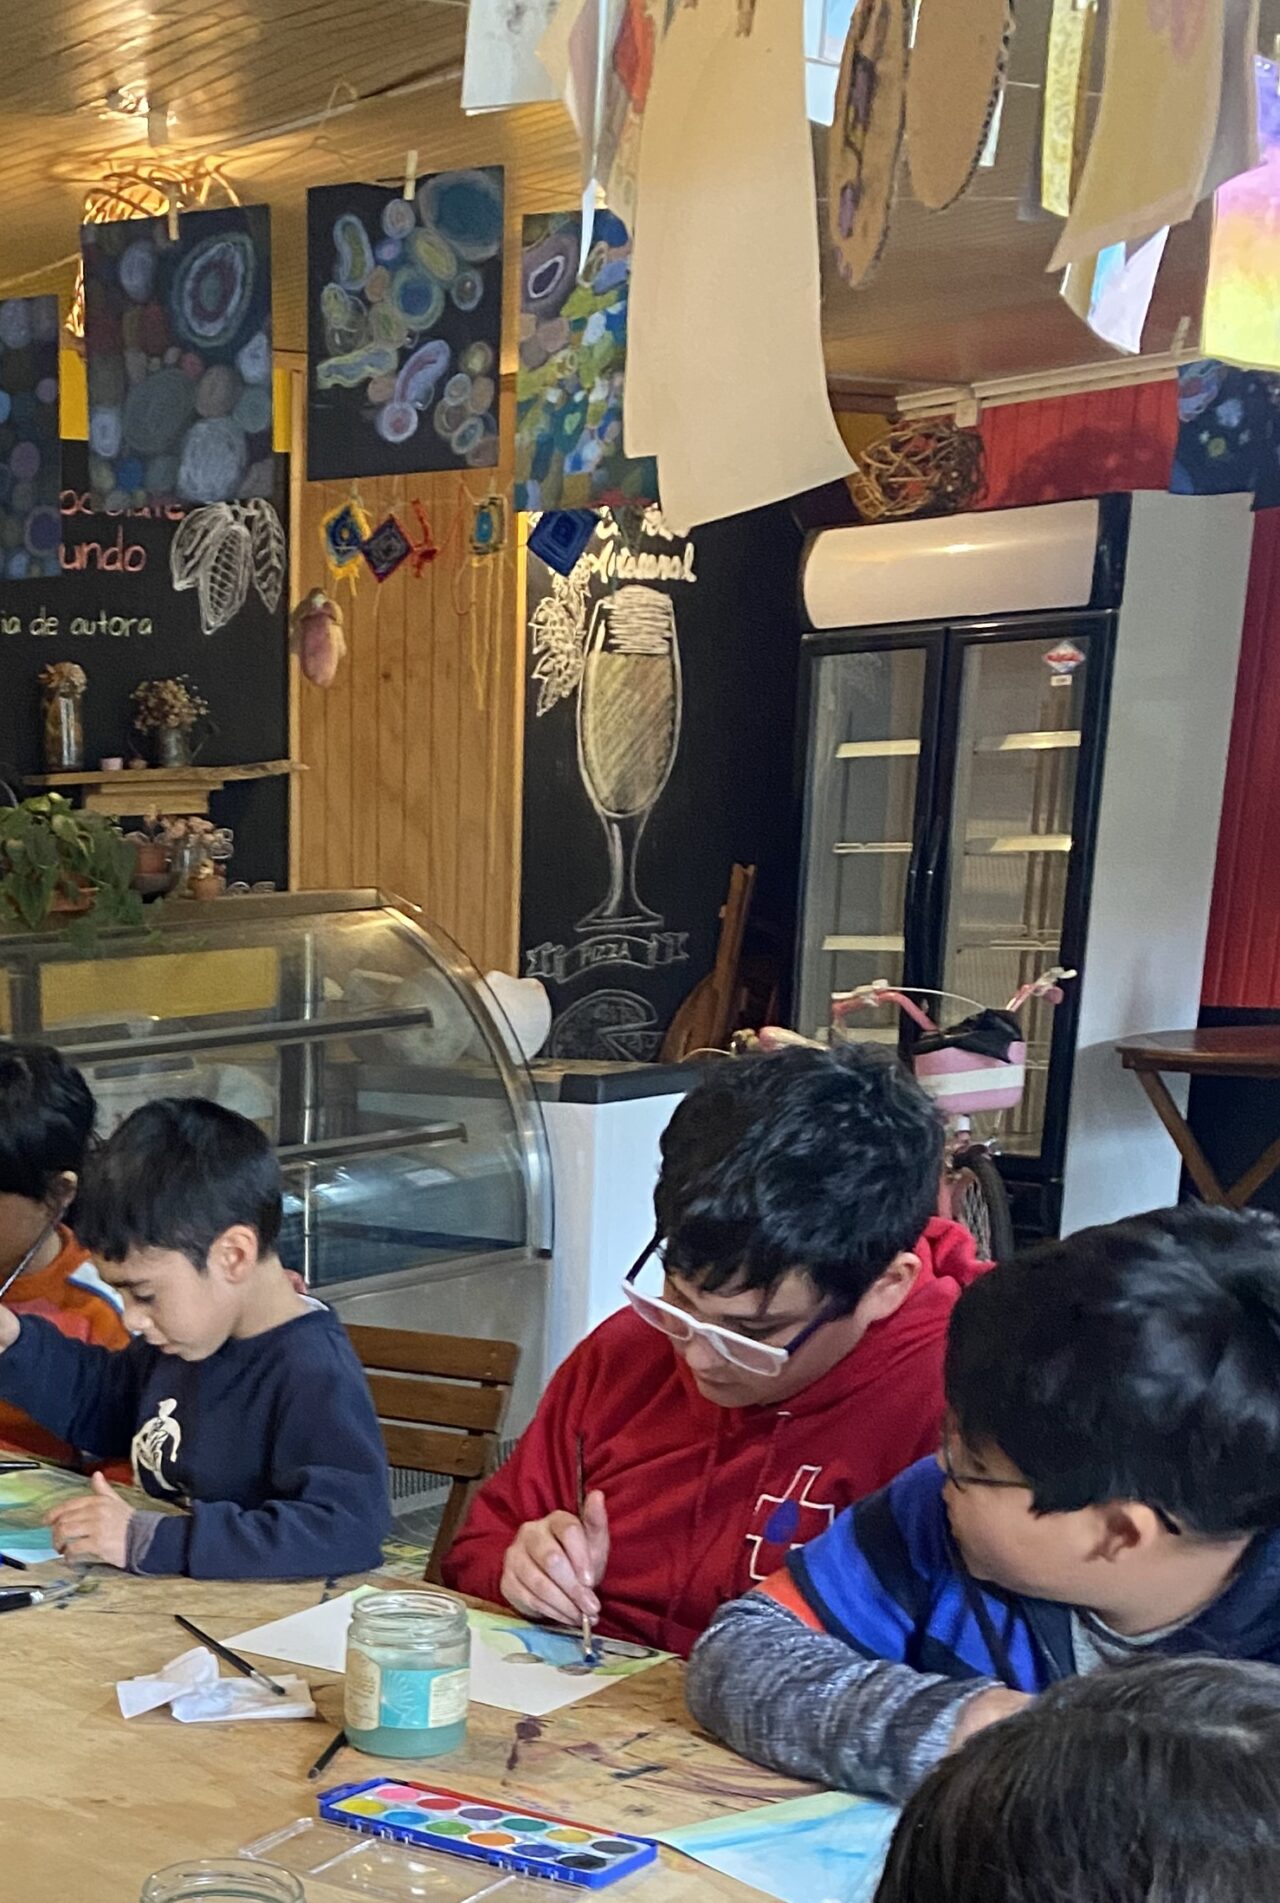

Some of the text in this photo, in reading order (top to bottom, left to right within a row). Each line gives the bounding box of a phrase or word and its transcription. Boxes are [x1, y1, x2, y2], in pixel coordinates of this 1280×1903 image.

[29, 605, 59, 636] de
[71, 609, 153, 637] autora
[580, 941, 632, 966] PIZZA
